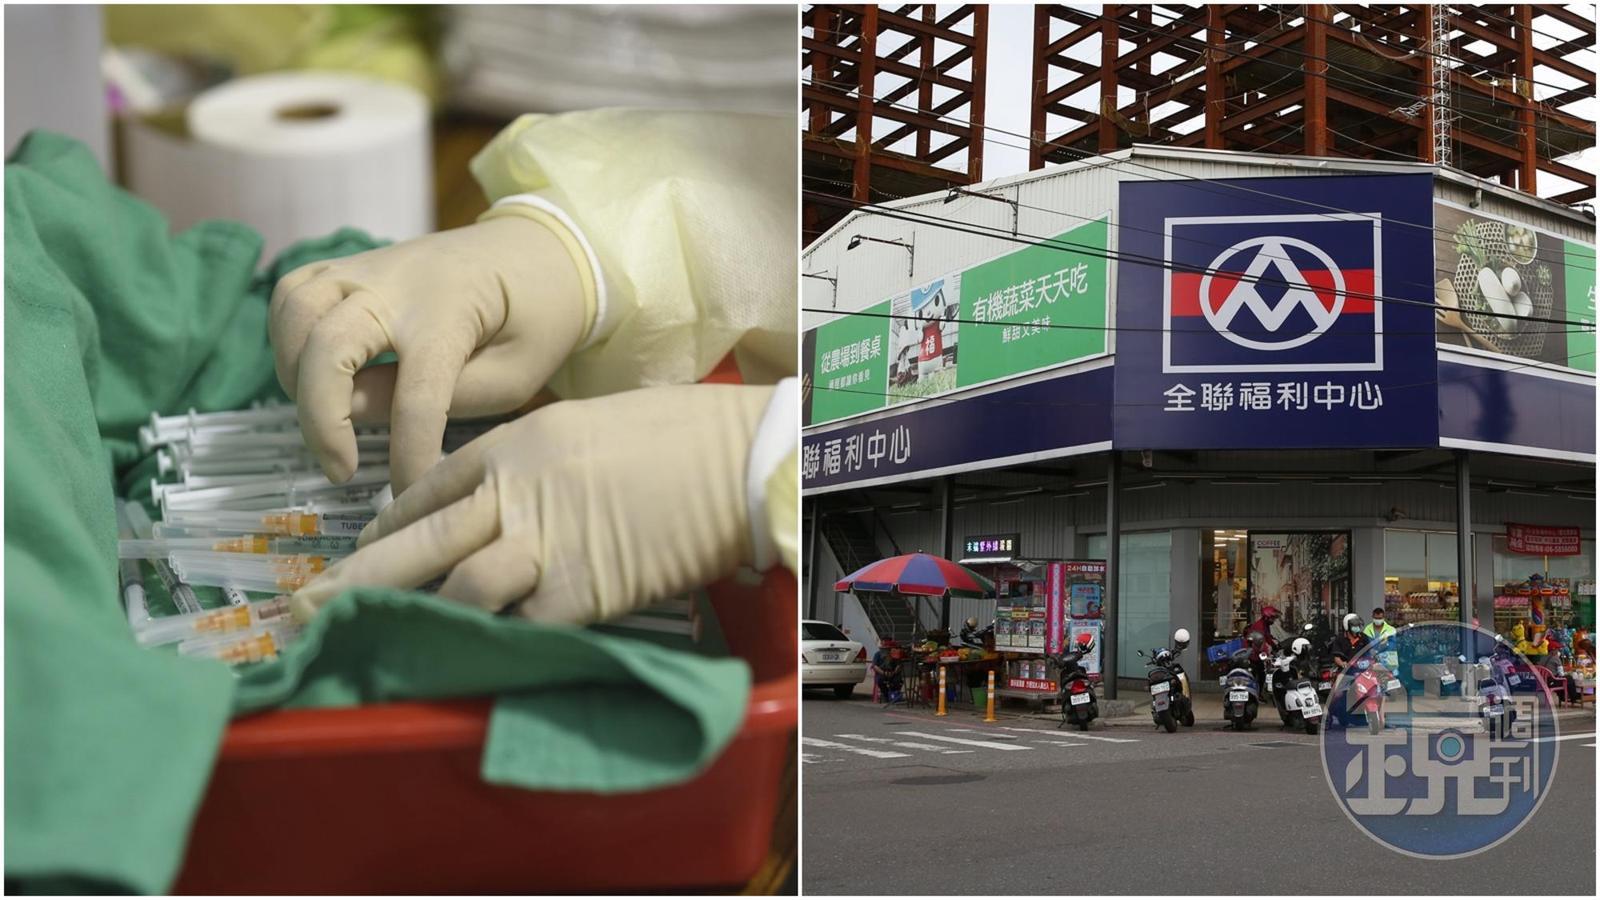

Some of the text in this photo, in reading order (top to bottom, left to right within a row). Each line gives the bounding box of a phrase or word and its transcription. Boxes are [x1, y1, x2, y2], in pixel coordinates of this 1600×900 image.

[972, 263, 1088, 326] 有機蔬菜天天吃
[925, 335, 936, 356] 福
[1002, 315, 1051, 343] 鮮甜又美味
[821, 335, 881, 374] 從農場到餐桌
[1163, 381, 1383, 411] 全聯福利中心
[802, 425, 911, 479] 聯福利中心
